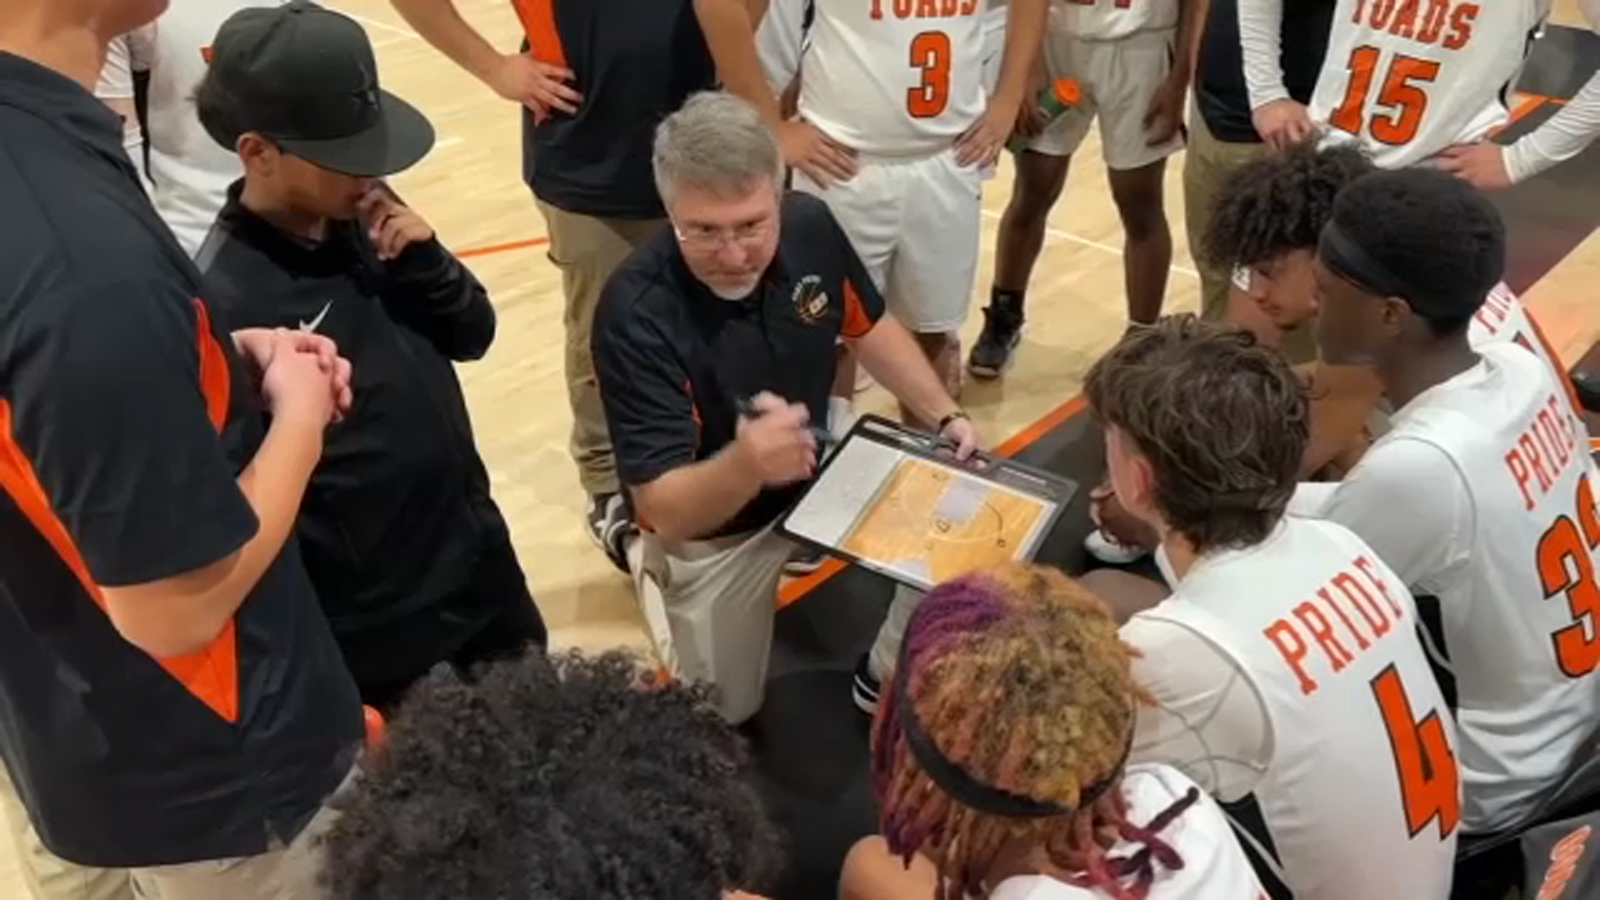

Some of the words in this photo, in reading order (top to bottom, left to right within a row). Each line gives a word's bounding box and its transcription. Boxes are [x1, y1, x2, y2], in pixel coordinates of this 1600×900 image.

[906, 30, 950, 119] 3
[1328, 45, 1441, 146] 15
[1262, 555, 1403, 695] PRIDE
[1368, 661, 1460, 843] 4
